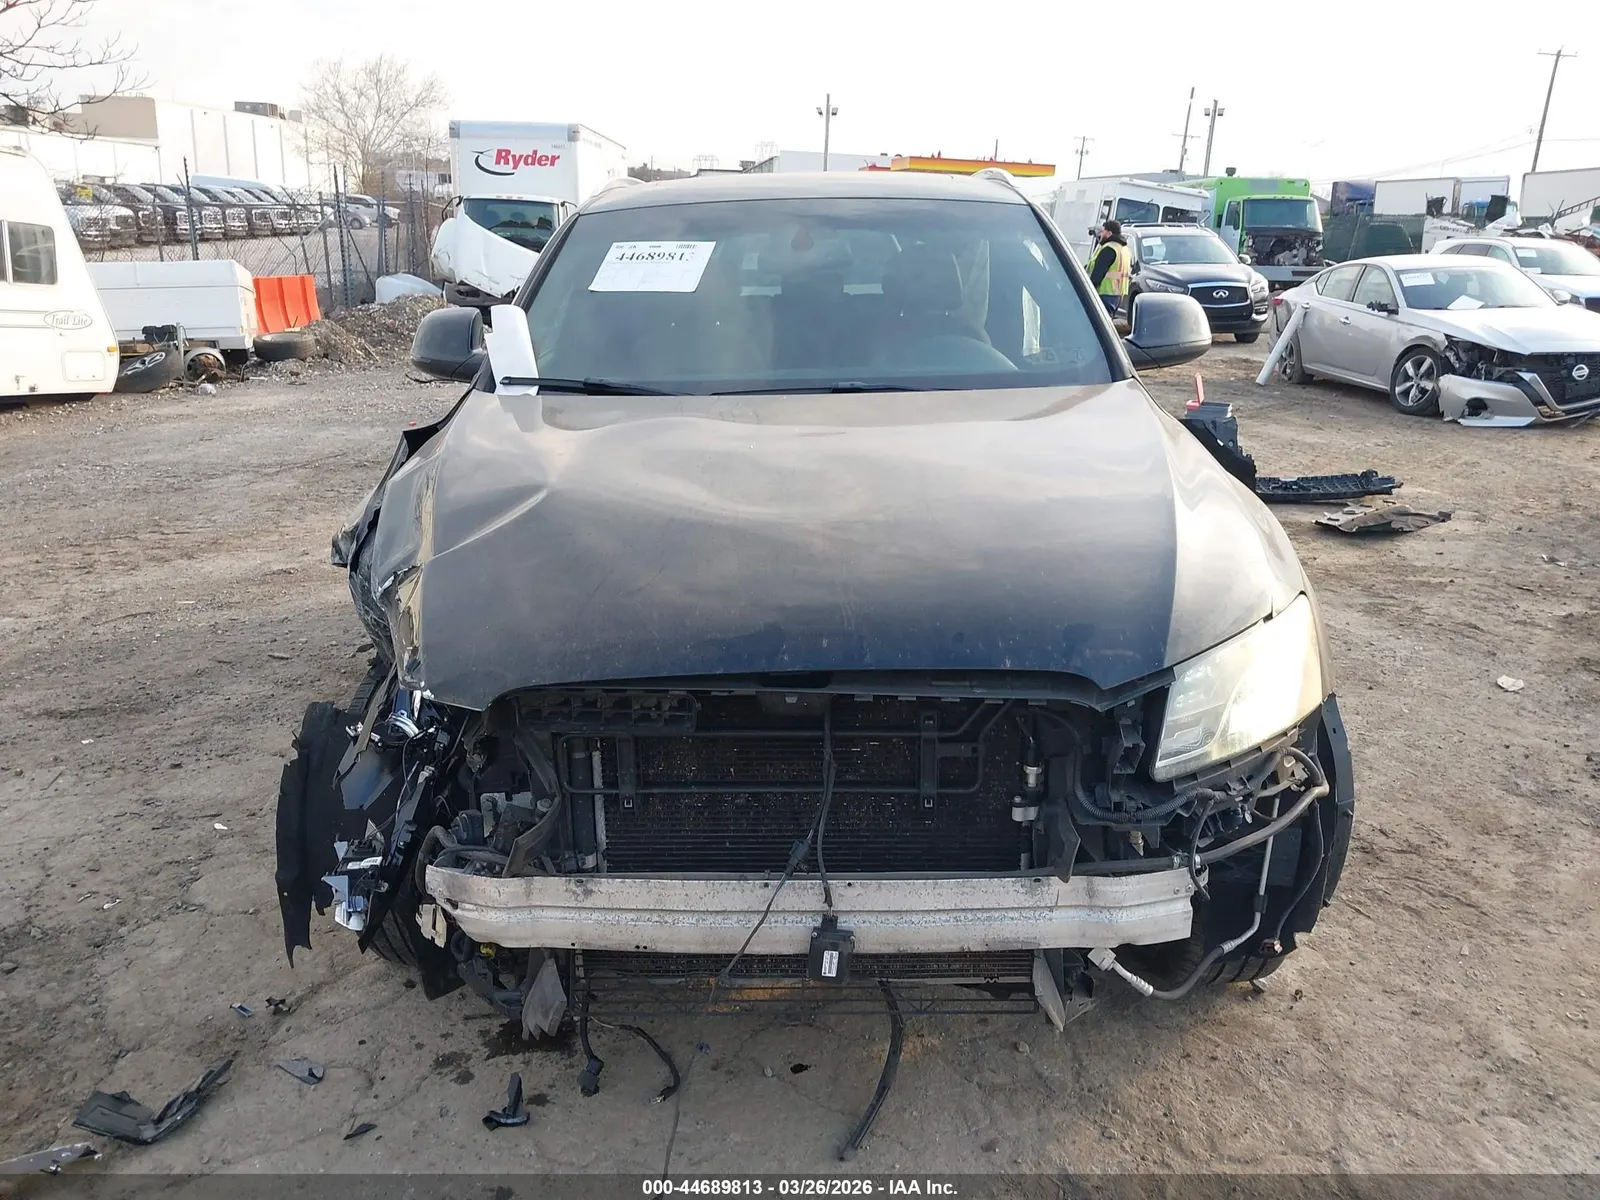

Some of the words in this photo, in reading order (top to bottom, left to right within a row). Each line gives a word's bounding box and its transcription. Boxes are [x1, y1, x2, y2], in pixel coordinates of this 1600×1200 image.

[495, 149, 560, 170] Ryder
[51, 314, 70, 326] Trail
[72, 315, 88, 326] Lite
